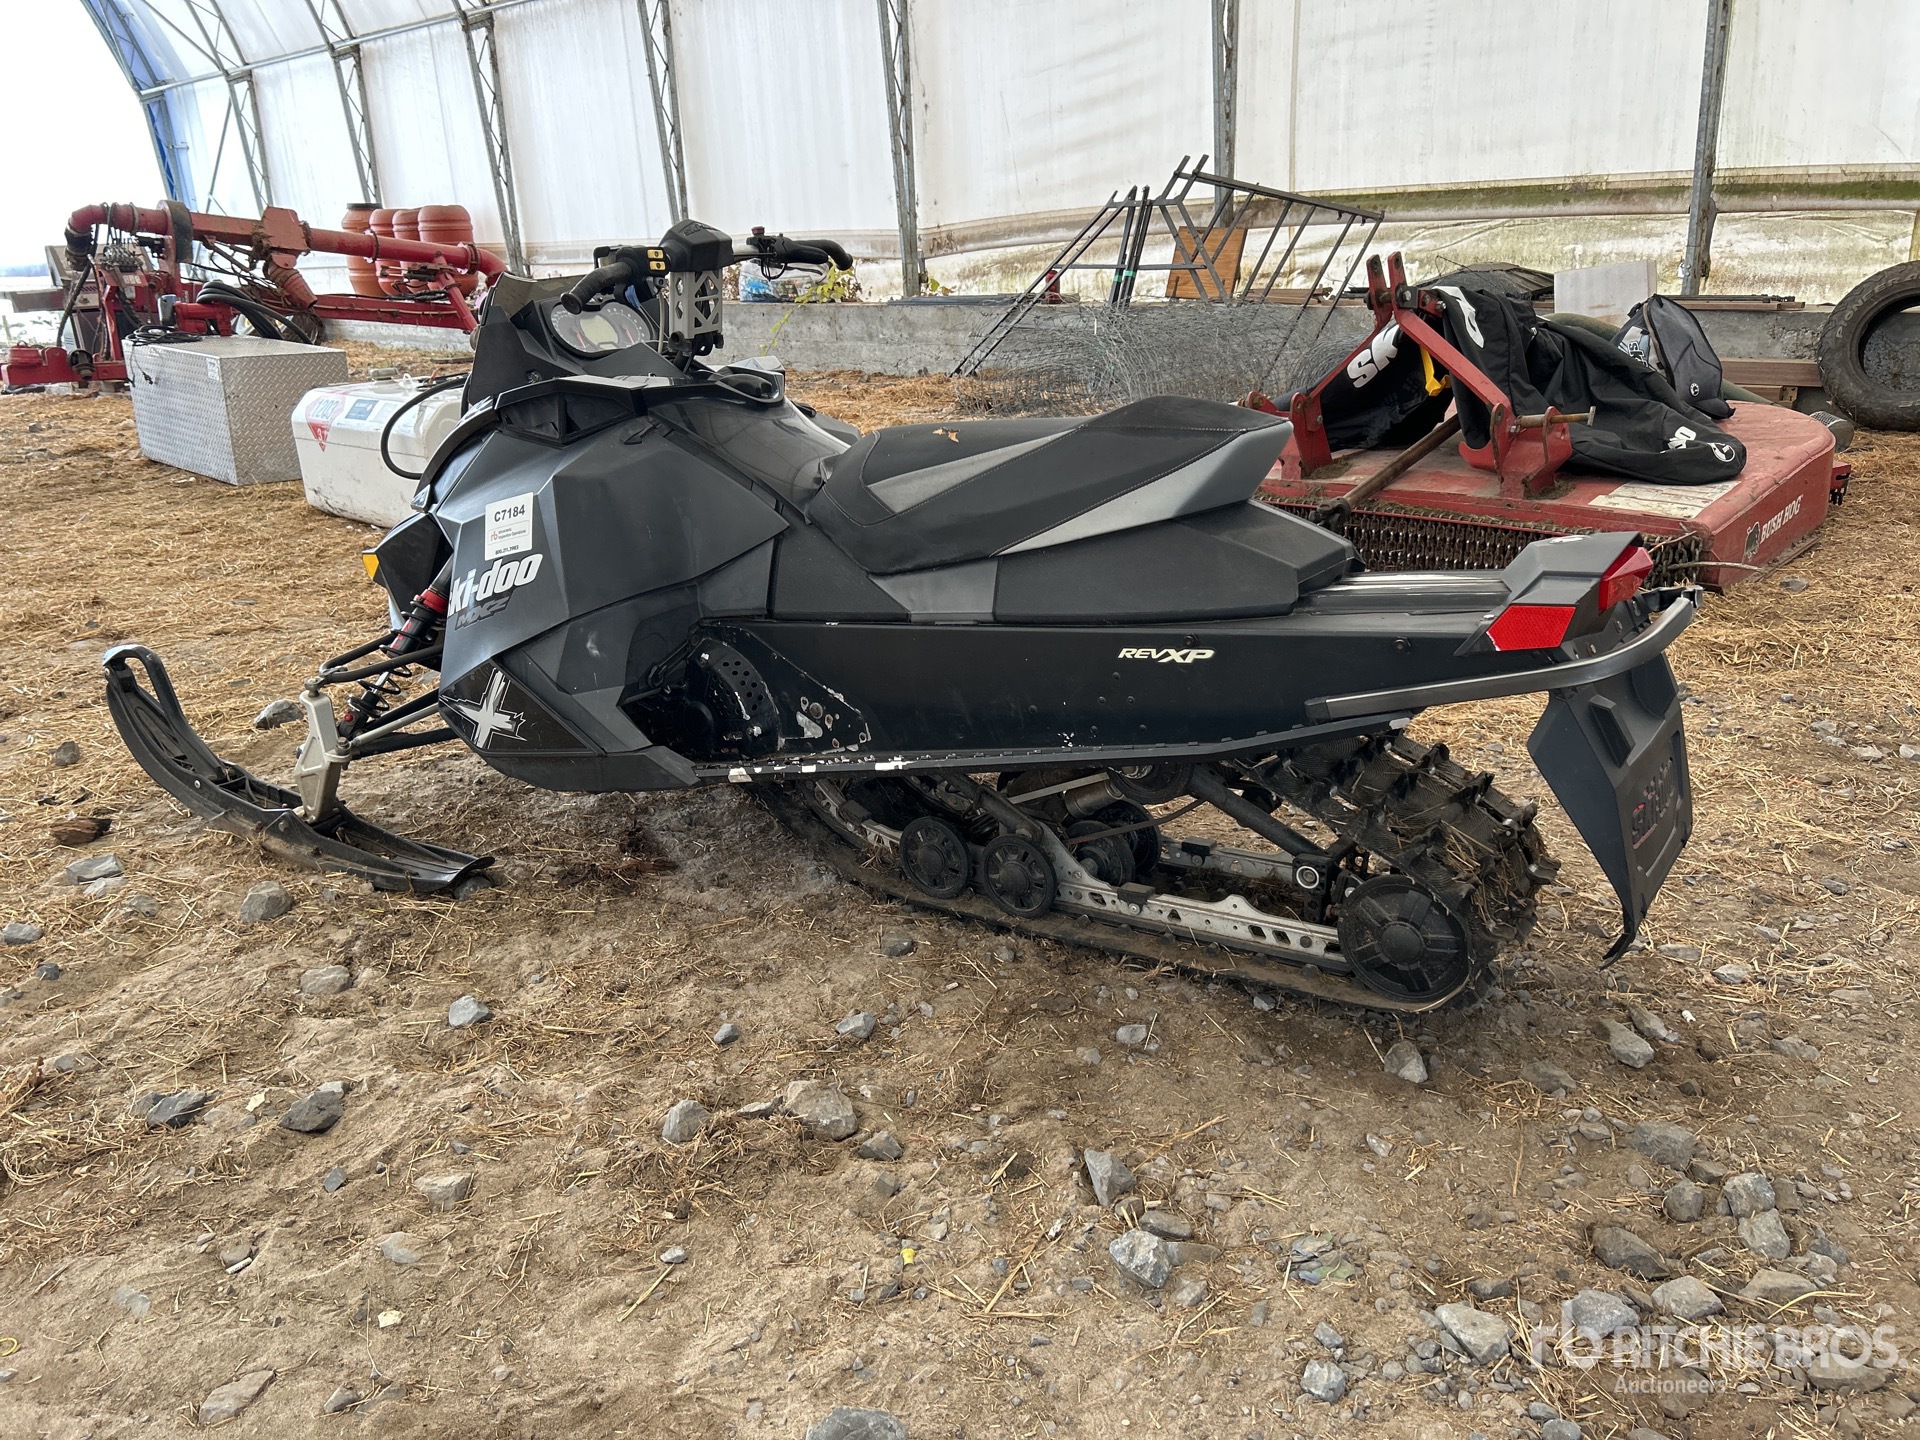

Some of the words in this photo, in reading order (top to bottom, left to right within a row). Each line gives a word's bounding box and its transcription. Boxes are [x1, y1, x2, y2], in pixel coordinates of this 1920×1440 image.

[1836, 278, 1900, 338] PIONEER
[494, 504, 525, 522] C7184
[448, 554, 543, 617] ki-doo
